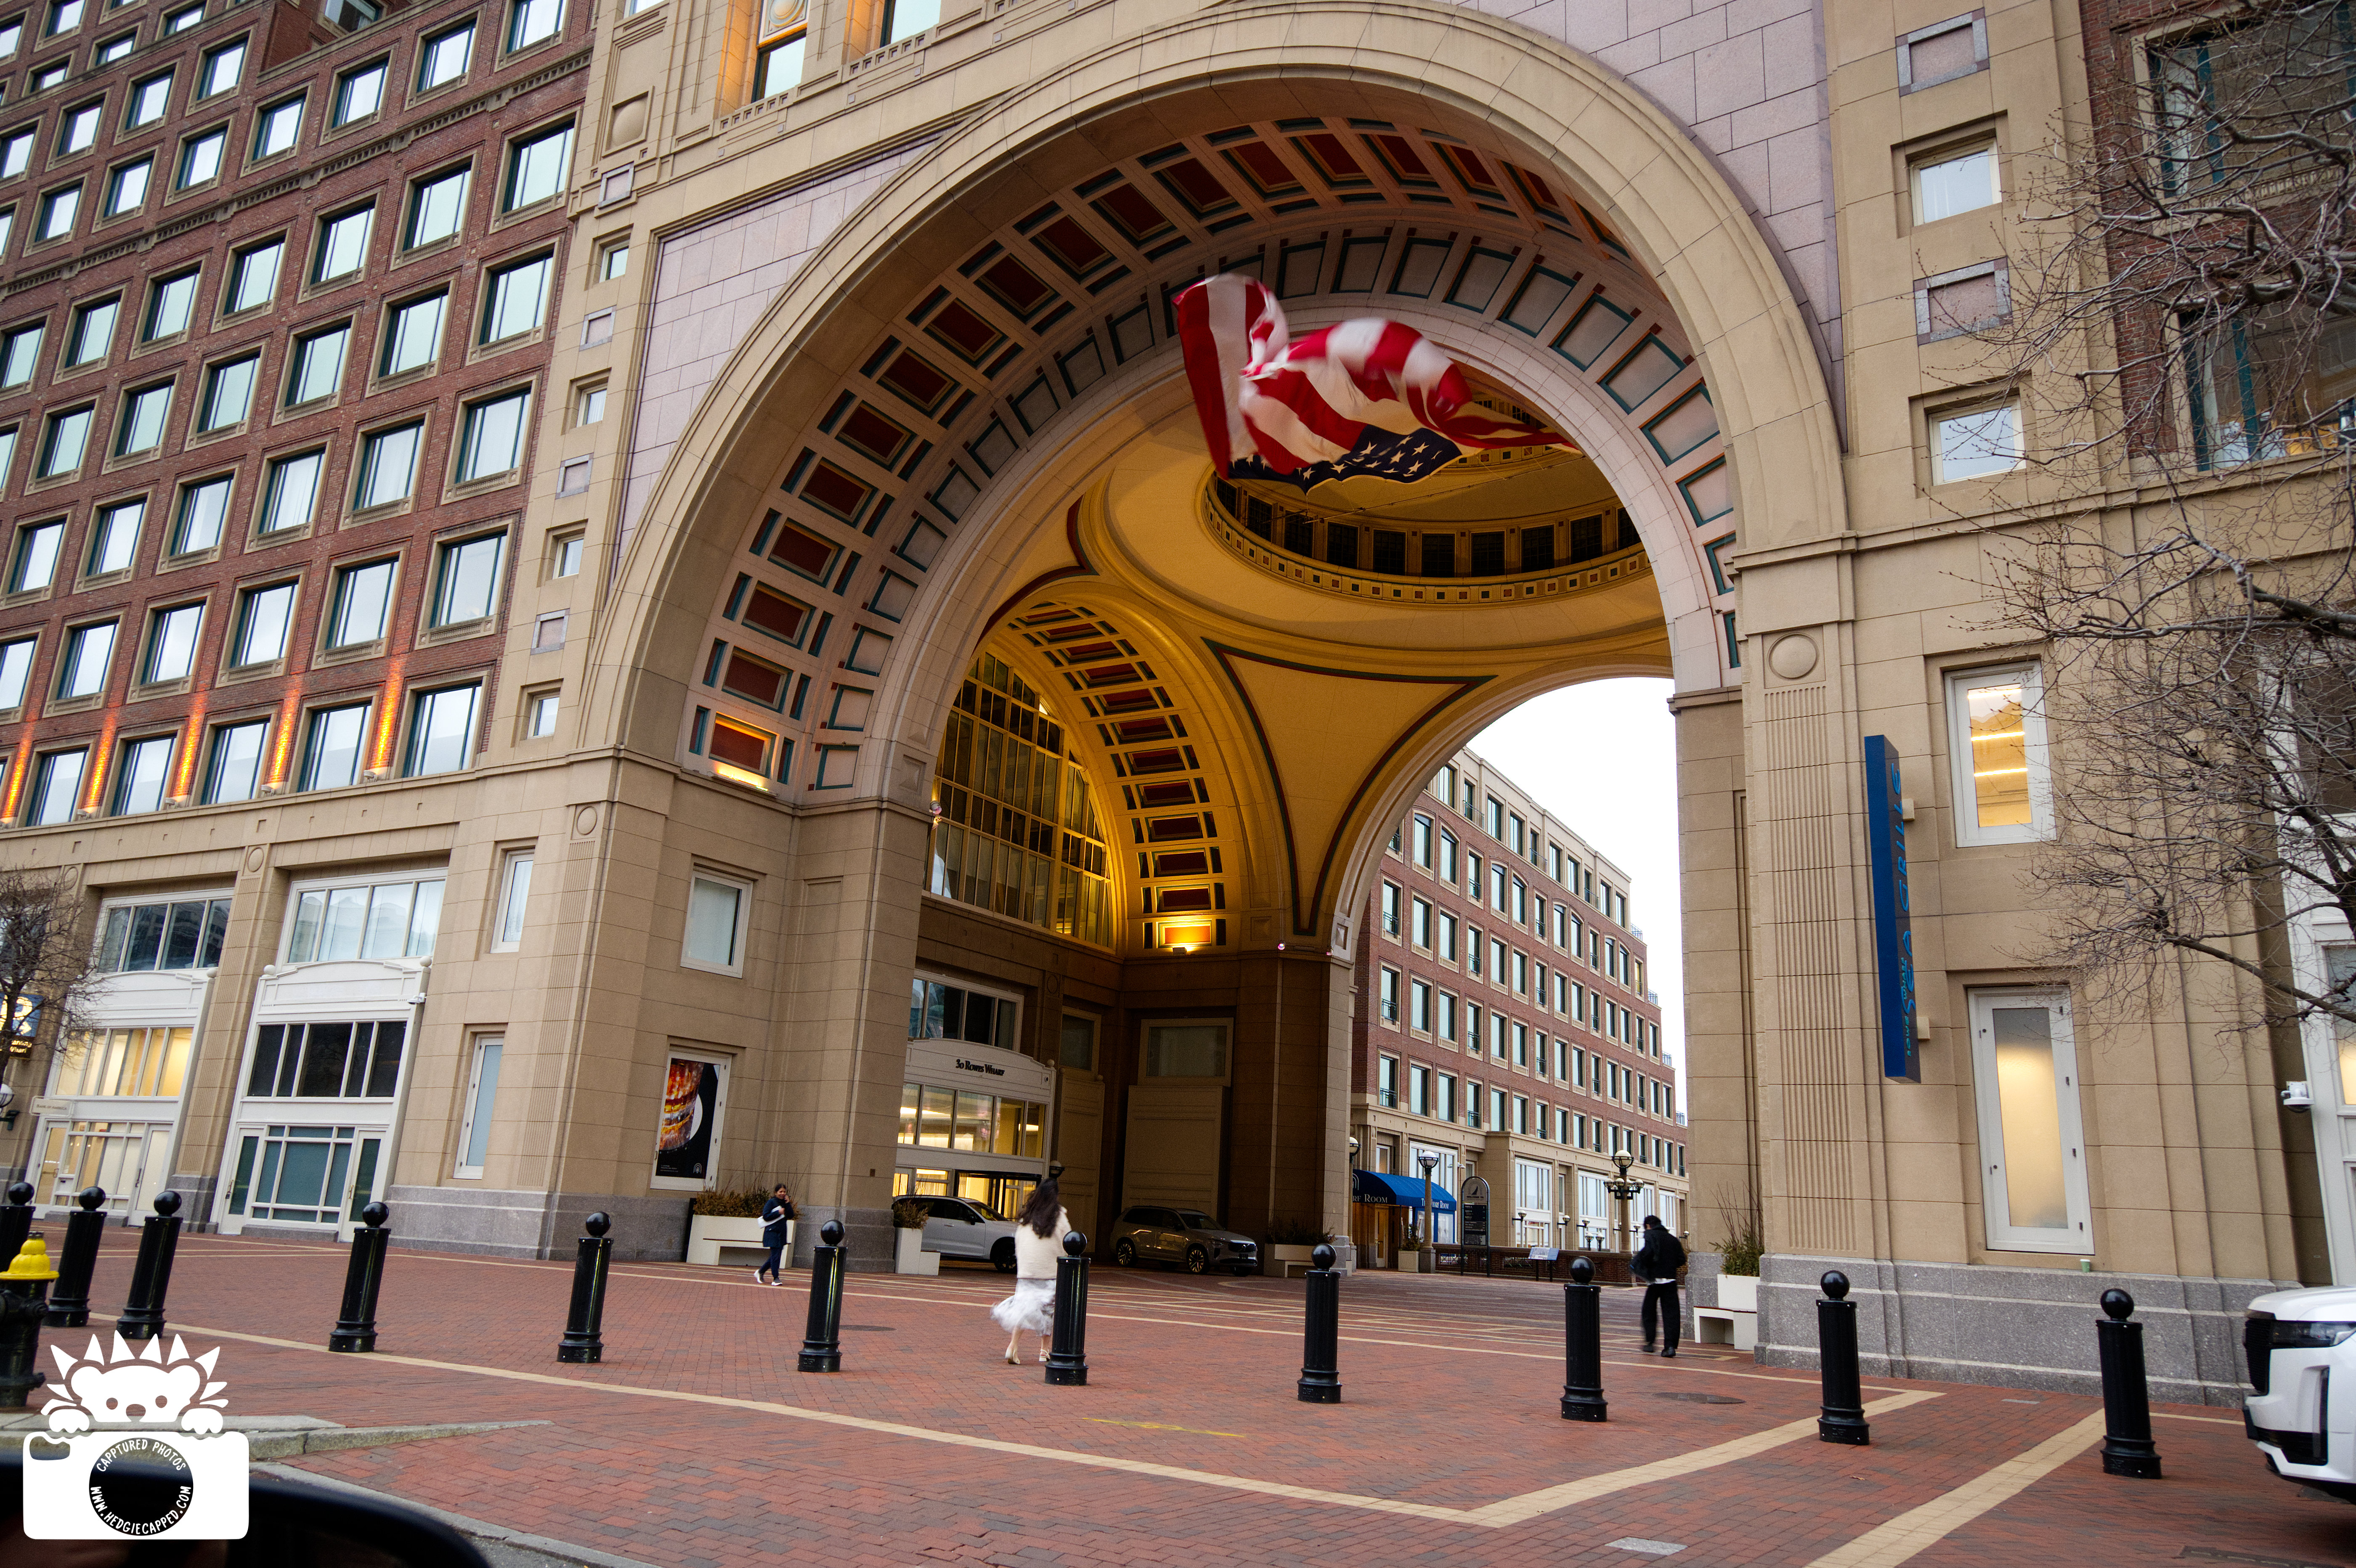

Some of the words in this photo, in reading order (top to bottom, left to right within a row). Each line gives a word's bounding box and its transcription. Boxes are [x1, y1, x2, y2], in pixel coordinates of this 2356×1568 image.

[1892, 763, 1909, 911] GRILLE
[1901, 930, 1916, 1014] SEA
[955, 1059, 964, 1069] 30
[964, 1060, 984, 1073] ROWES
[984, 1064, 1005, 1076] WHARF
[1364, 1194, 1388, 1203] ROOM
[1440, 1200, 1449, 1209] ROOM
